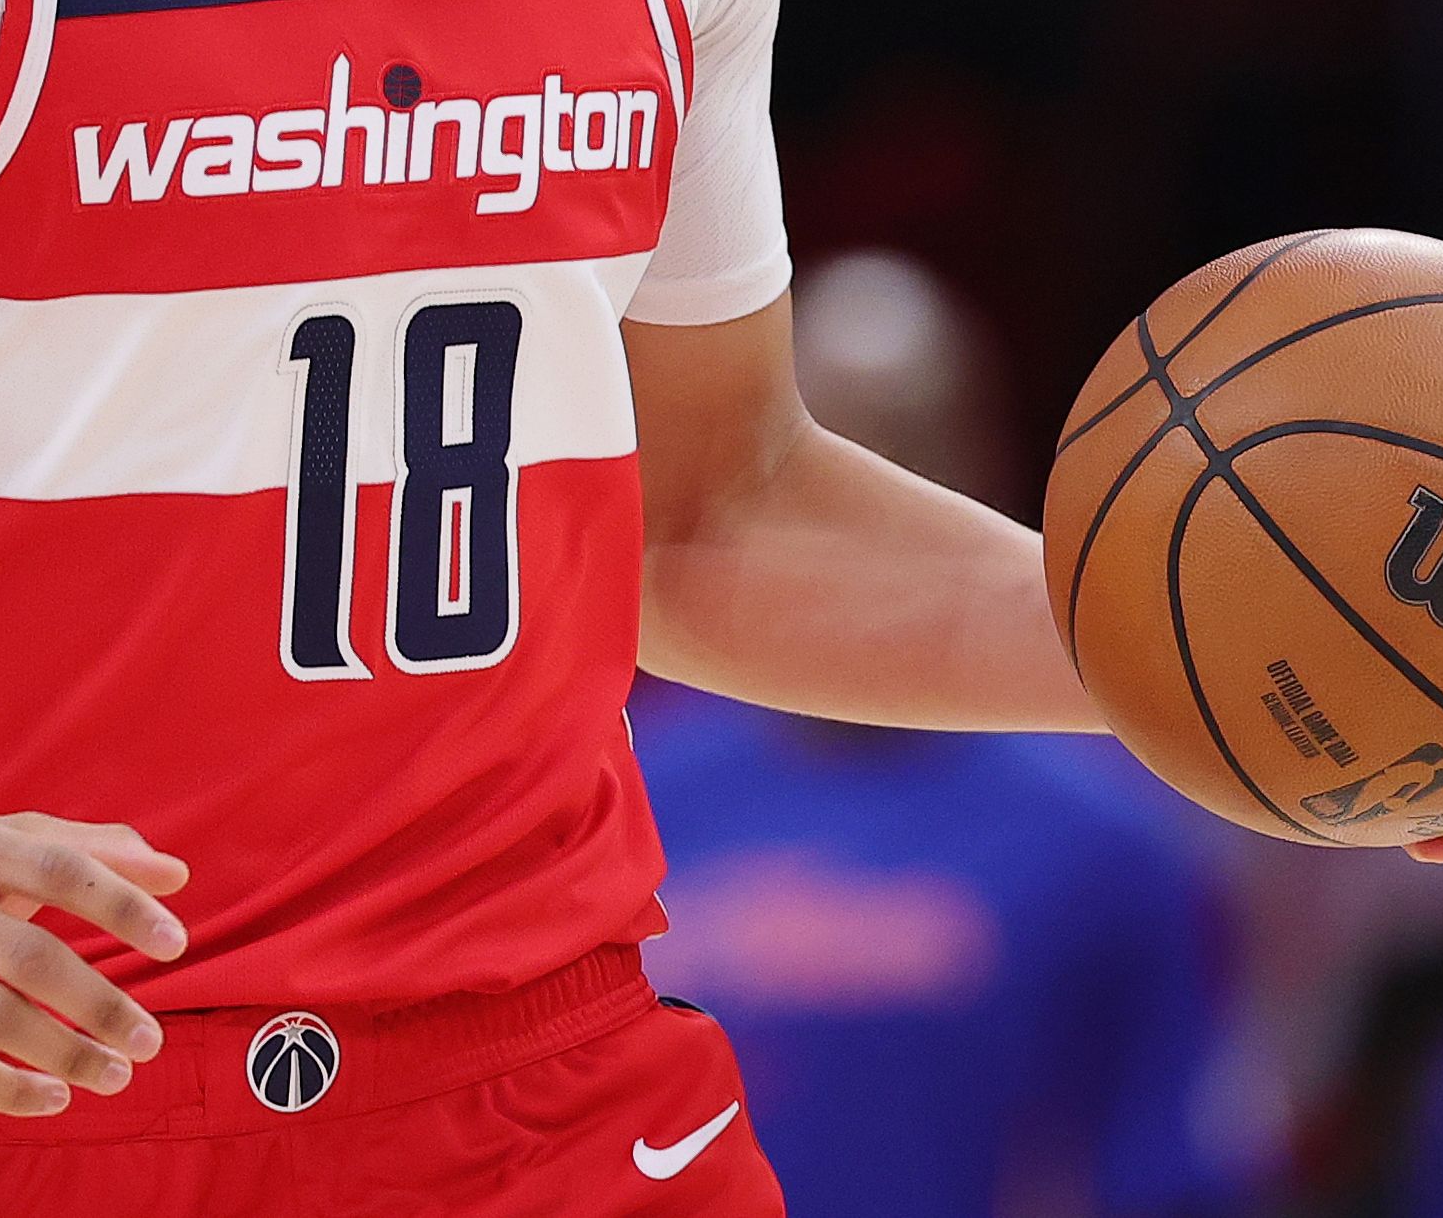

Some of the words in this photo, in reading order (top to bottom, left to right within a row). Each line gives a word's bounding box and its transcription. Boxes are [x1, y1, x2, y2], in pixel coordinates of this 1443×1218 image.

[73, 51, 658, 215] washington
[279, 290, 524, 682] 18
[1266, 659, 1315, 716] OFFICIAL
[1301, 710, 1339, 745] GAME
